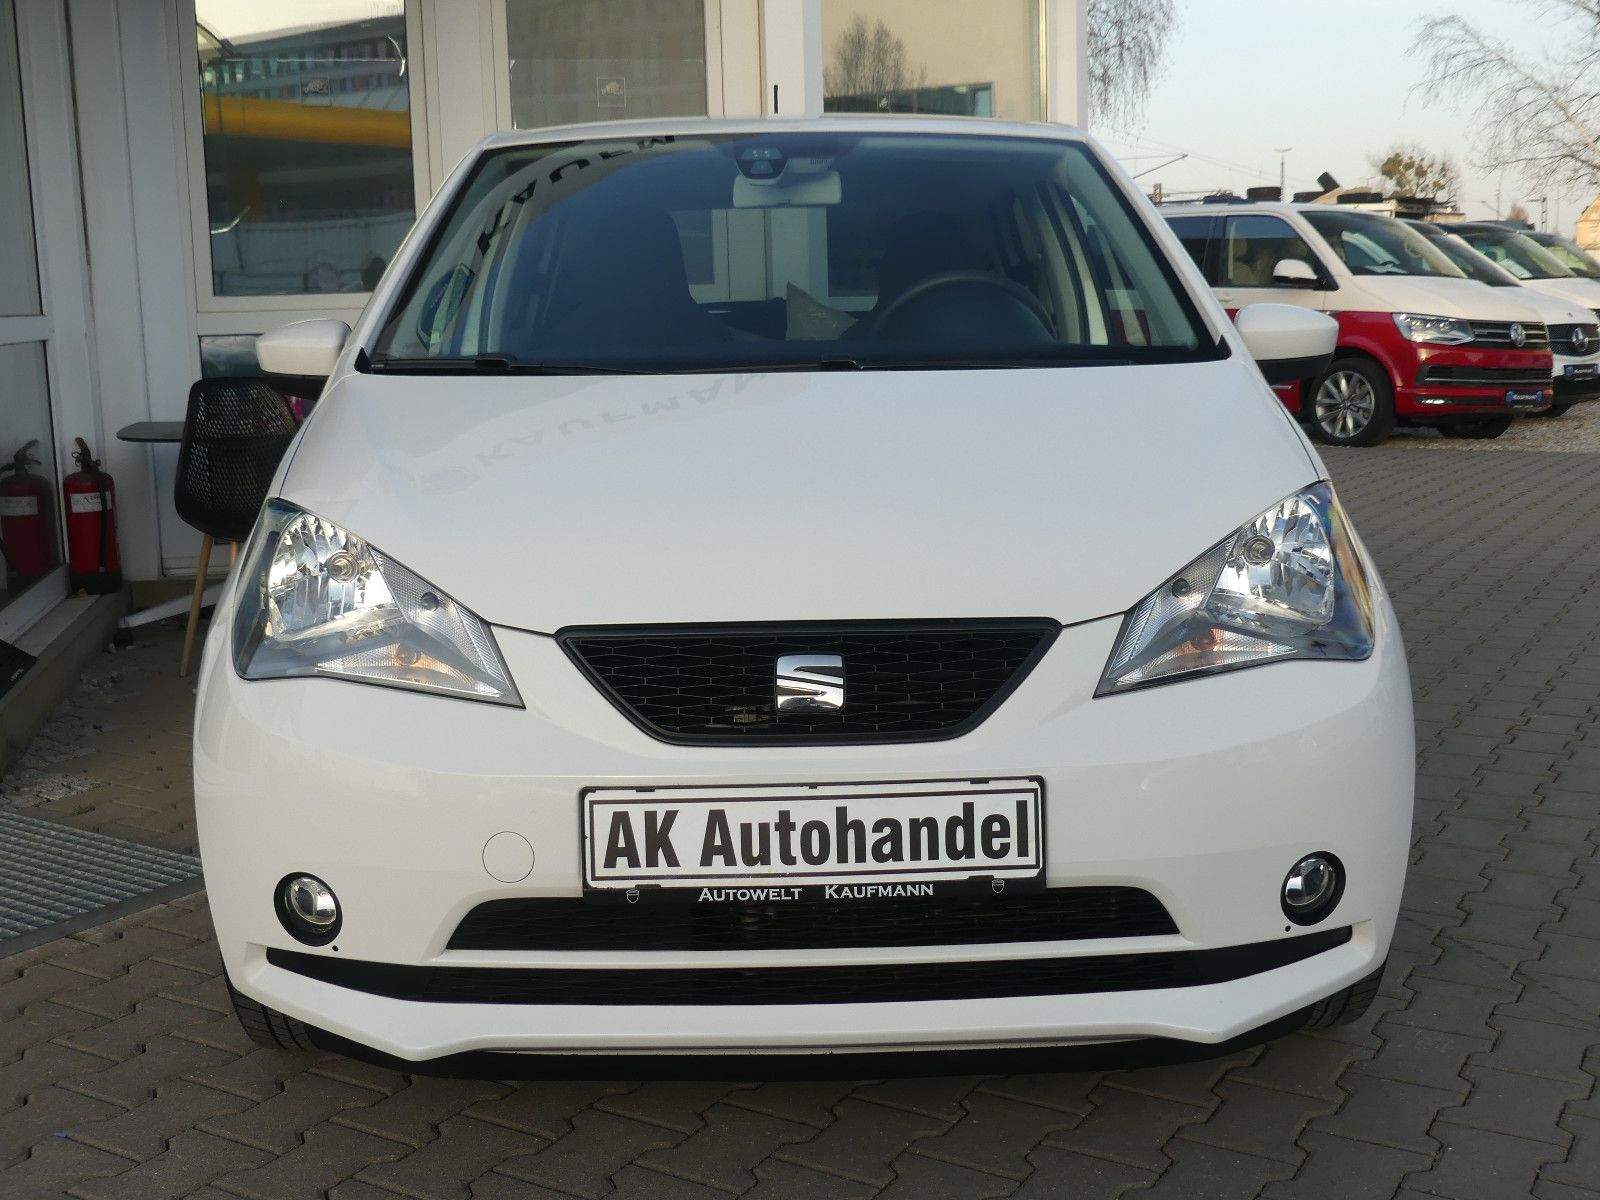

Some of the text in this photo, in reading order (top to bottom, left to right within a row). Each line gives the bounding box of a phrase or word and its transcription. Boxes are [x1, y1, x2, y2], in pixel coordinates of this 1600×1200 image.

[603, 799, 1029, 869] AK Autohandel
[698, 883, 934, 902] AUTOWELT KAUFMANN
